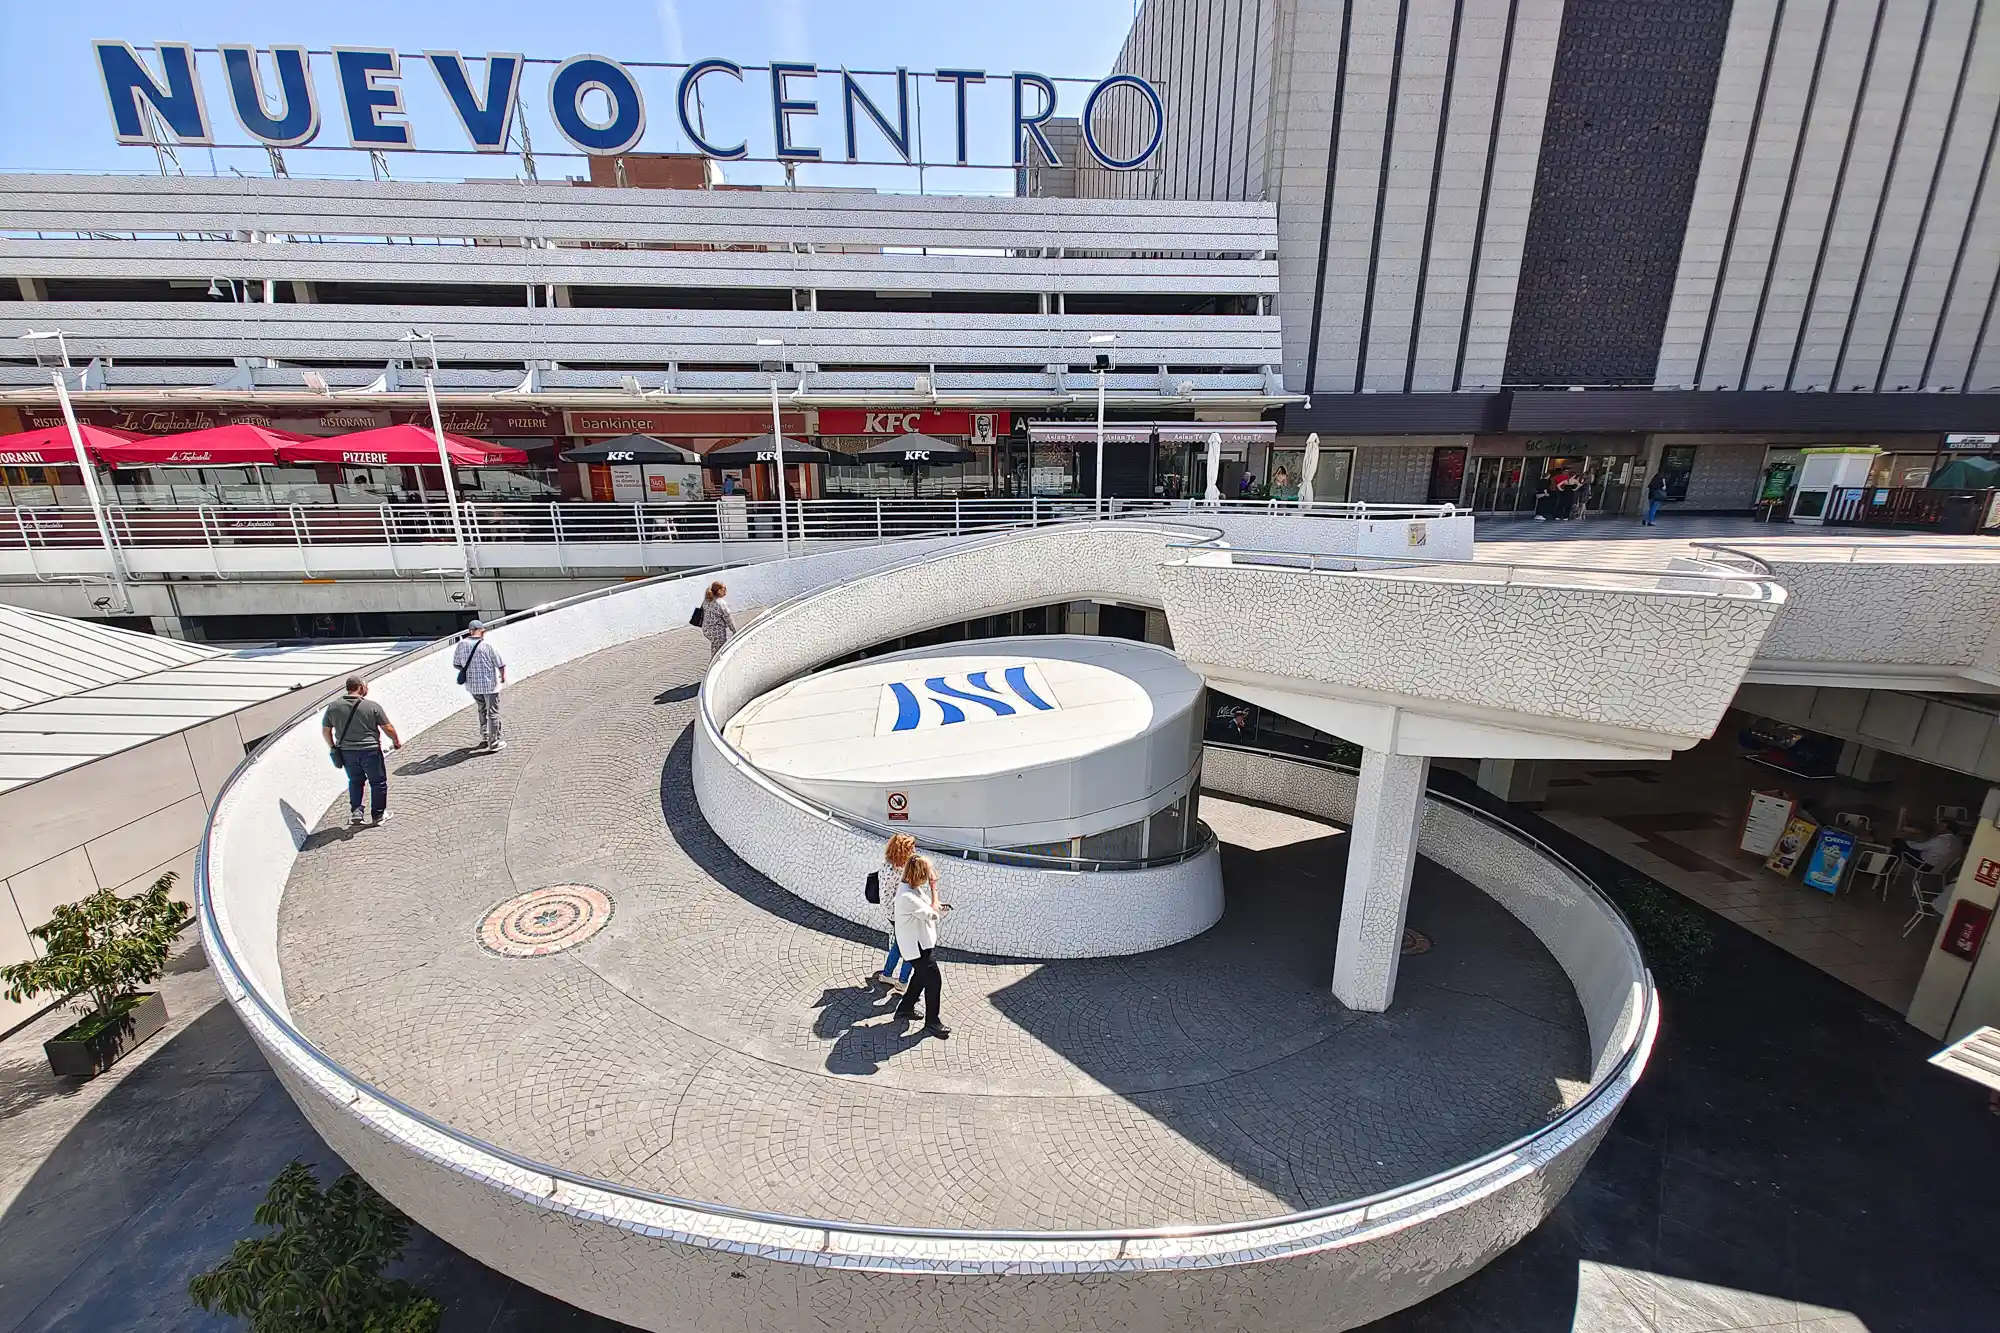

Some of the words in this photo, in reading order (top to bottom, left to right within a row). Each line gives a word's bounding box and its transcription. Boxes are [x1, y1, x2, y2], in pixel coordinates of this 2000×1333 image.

[91, 38, 647, 155] NUEVO
[676, 57, 1165, 171] CENTRO
[112, 411, 143, 430] La
[140, 411, 211, 432] Tagliatella
[320, 417, 376, 428] RISTORANTI
[508, 418, 547, 428] PIZZERIE
[862, 413, 920, 433] KFC
[343, 451, 388, 463] PIZZERIE
[606, 451, 635, 461] KFC
[904, 450, 930, 461] KFC
